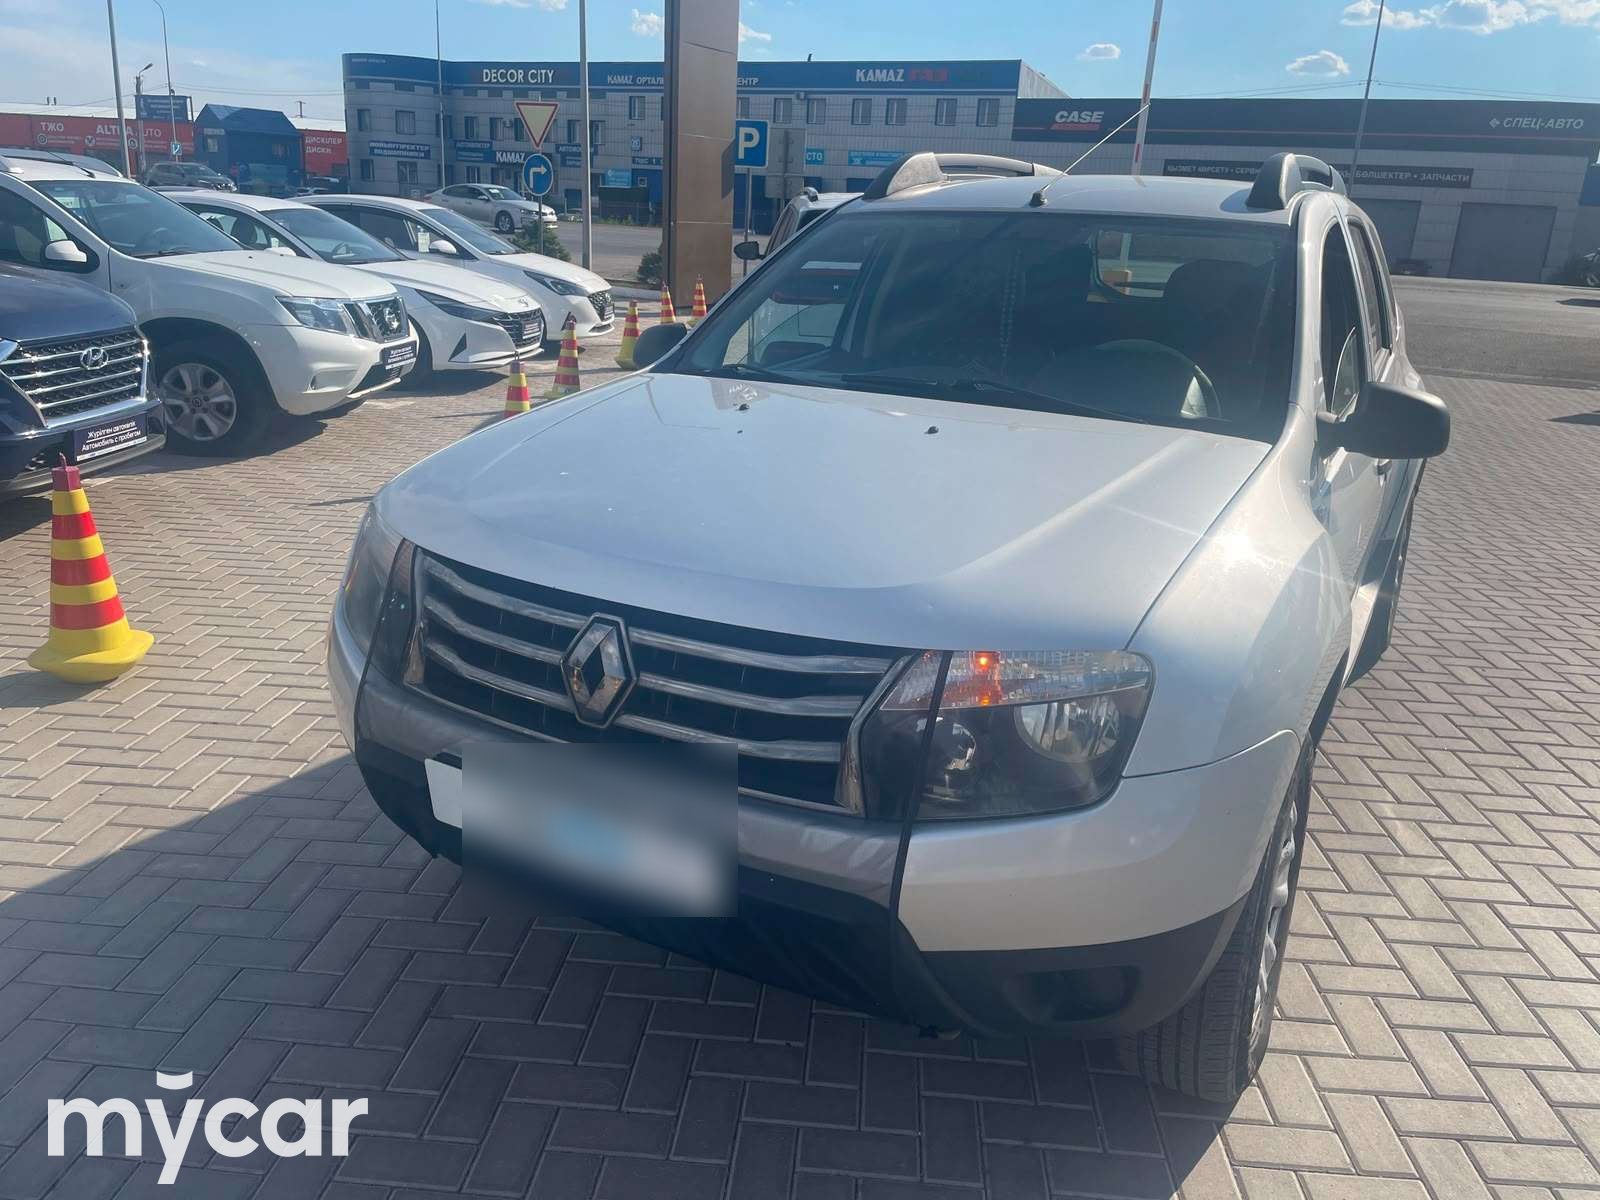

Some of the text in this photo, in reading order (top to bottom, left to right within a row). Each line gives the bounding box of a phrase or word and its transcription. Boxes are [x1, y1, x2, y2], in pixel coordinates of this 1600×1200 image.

[482, 69, 555, 84] DECOR CITY
[607, 74, 634, 84] KAMAZ
[736, 77, 760, 87] ЕНТР
[855, 68, 905, 82] KAMAZ
[1055, 110, 1105, 123] CASE
[40, 121, 65, 132] ТЖО
[1503, 117, 1585, 130] СПЕЦ-АВТО
[738, 127, 759, 159] P
[495, 151, 526, 164] KAMAZ
[806, 151, 823, 161] СТО
[1420, 173, 1471, 183] ЗАПЧАСТИ
